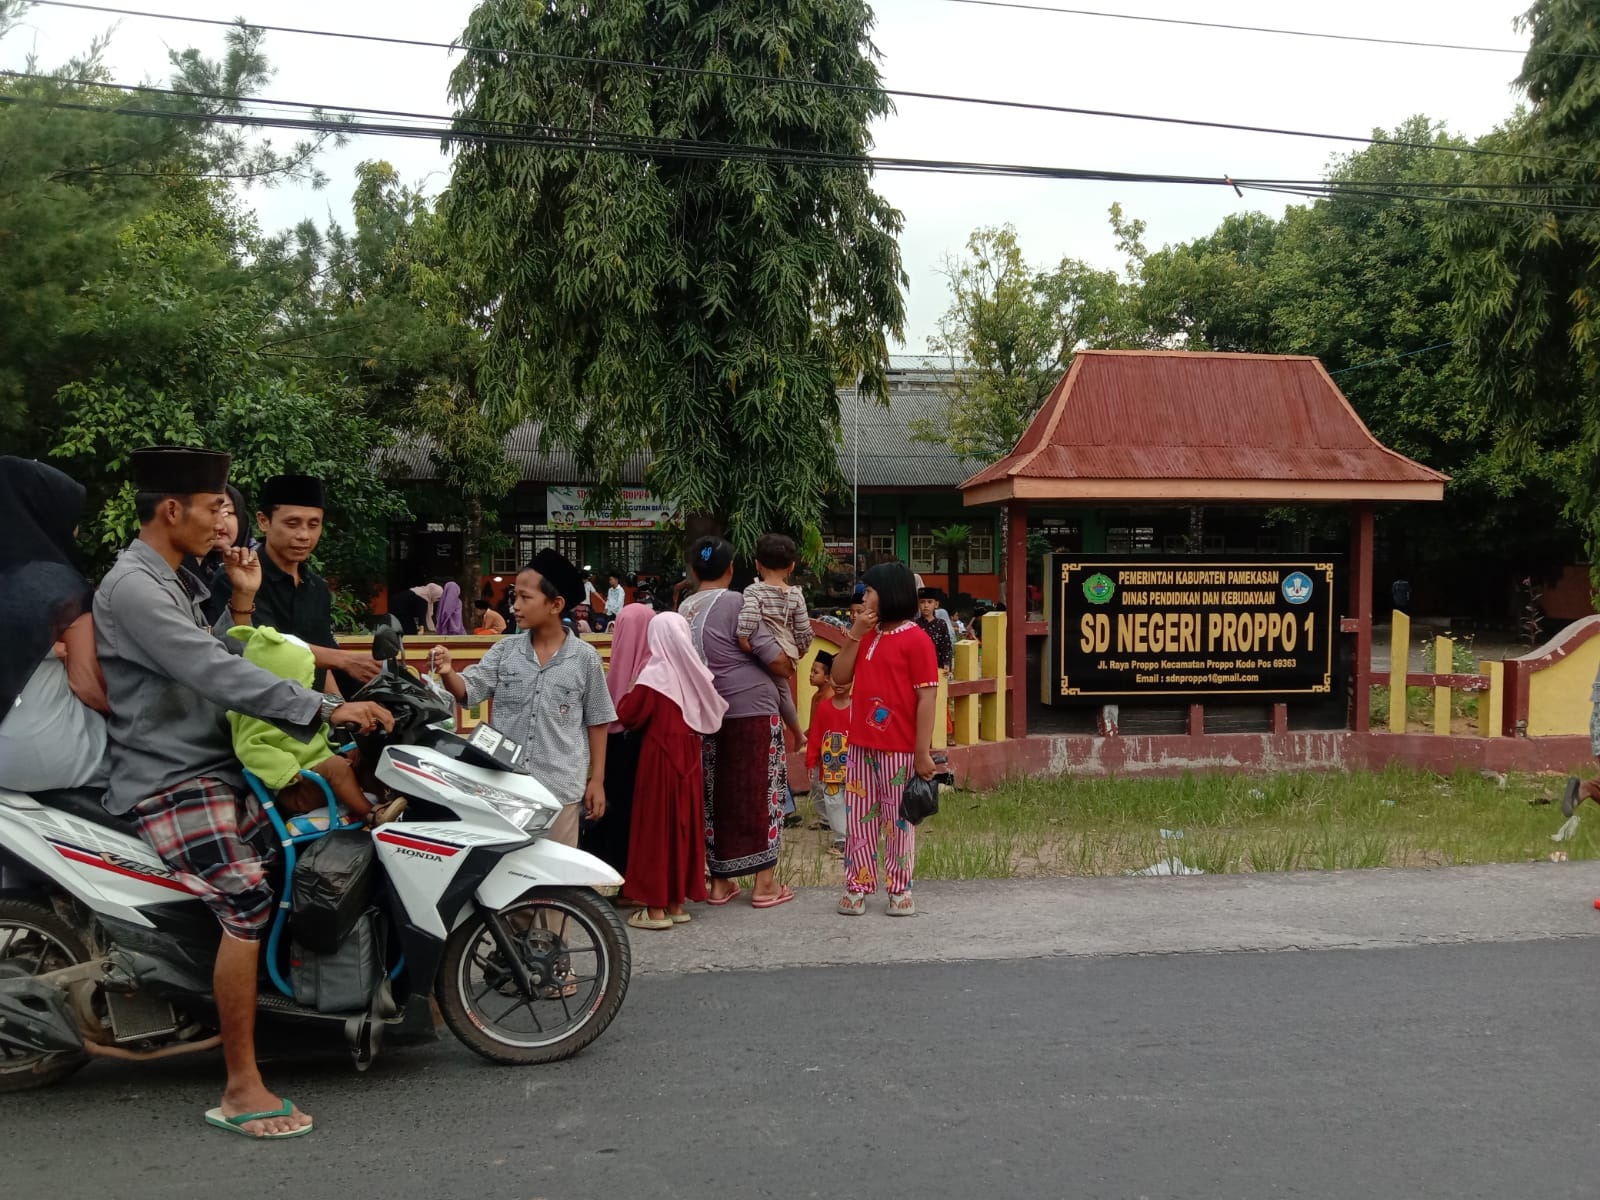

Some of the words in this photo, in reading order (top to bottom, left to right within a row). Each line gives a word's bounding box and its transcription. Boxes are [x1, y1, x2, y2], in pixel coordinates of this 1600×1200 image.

[1119, 570, 1174, 585] PEMERINTAH
[1175, 570, 1226, 585] KABUPATEN
[1228, 570, 1279, 585] PAMEKASAN
[1122, 591, 1148, 606] DINAS
[1149, 591, 1201, 606] PENDIDIKAN
[1202, 591, 1219, 605] DAN
[1221, 591, 1276, 605] KEBUDAYAAN
[1080, 612, 1111, 654] SD
[1117, 612, 1202, 653] NEGERI
[1208, 611, 1298, 653] PROPPO
[1304, 612, 1315, 652] 1
[1097, 660, 1108, 670] Jl.
[1109, 660, 1130, 672] Raya
[1131, 660, 1160, 671] Proppo
[1160, 659, 1206, 670] Kecamatan
[1206, 659, 1235, 670] Proppo
[1235, 659, 1256, 669] Kode
[1257, 659, 1272, 669] Pos
[1135, 673, 1160, 683] Email
[1165, 673, 1260, 685] sdnproppo1@gmail.com
[396, 847, 443, 863] HONDA
